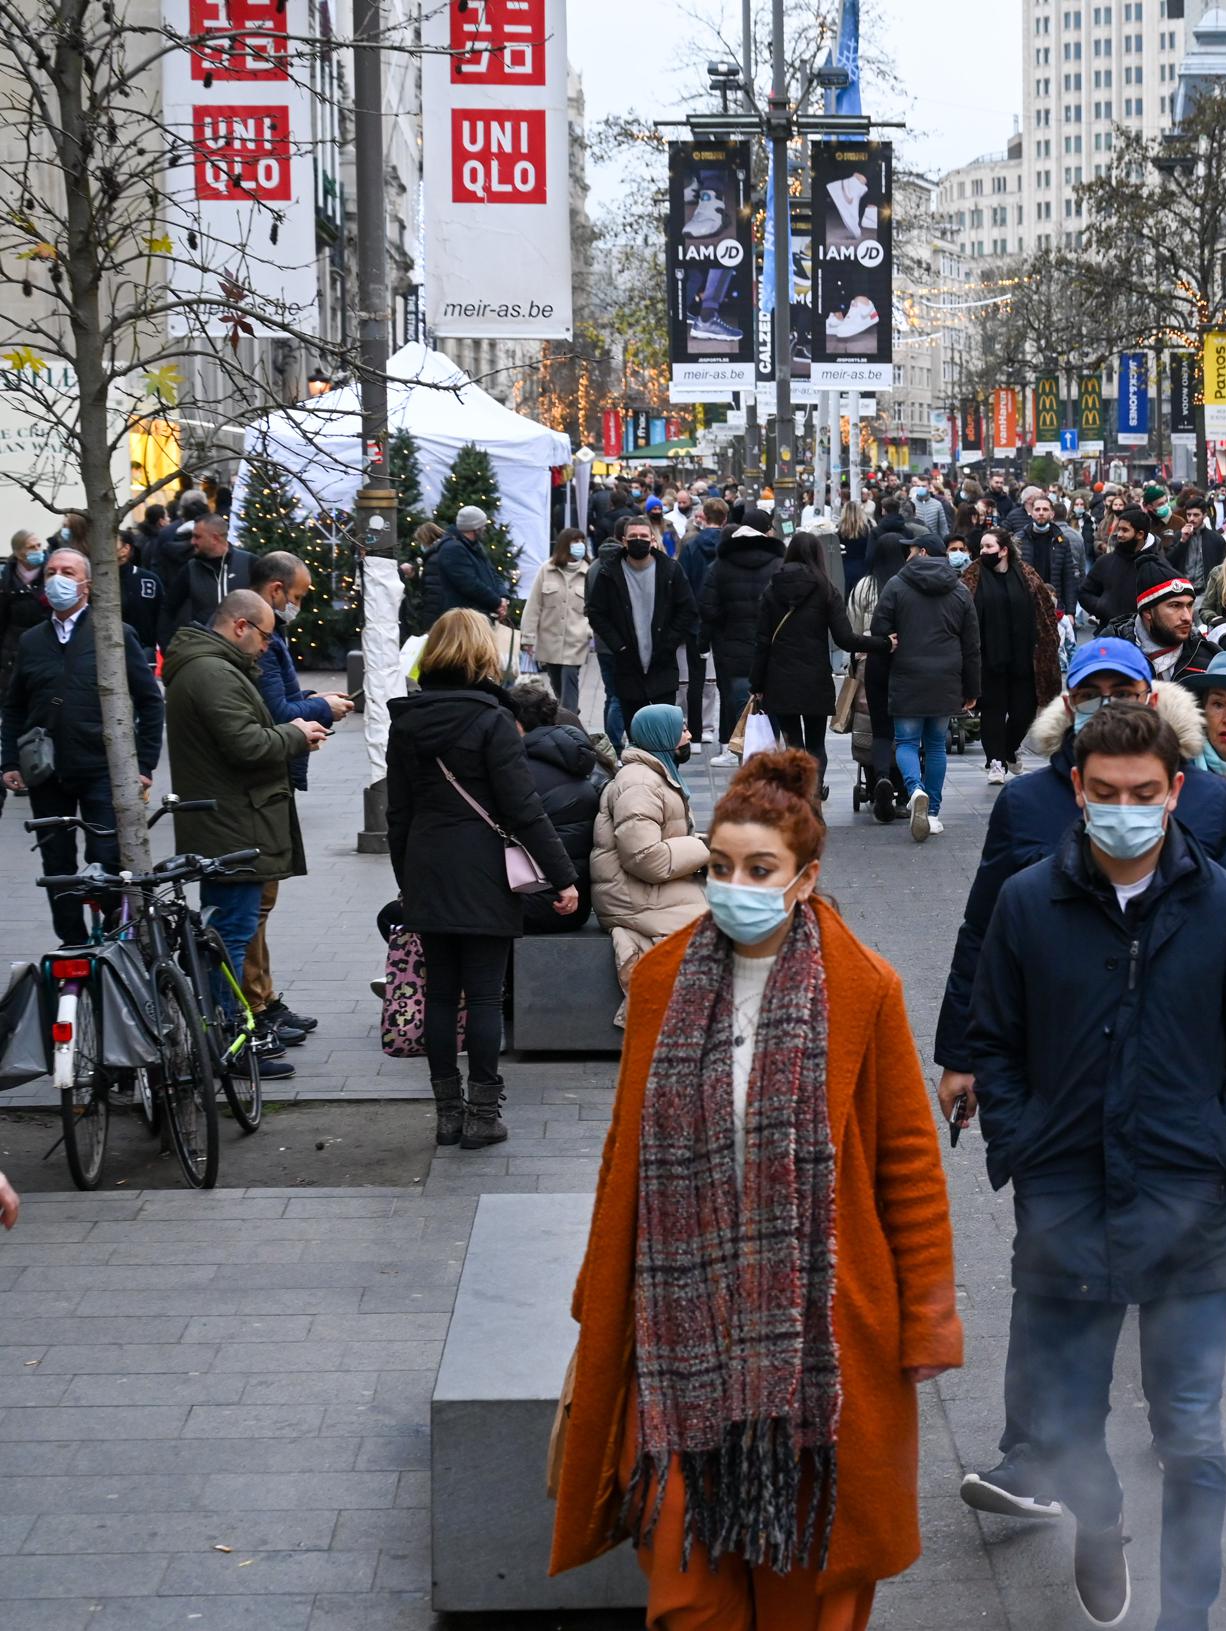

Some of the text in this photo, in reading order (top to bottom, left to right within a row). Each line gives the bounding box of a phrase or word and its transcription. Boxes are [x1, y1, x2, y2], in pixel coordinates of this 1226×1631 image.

[204, 117, 273, 150] UNI
[462, 121, 528, 153] UNI
[204, 156, 280, 195] QLO
[463, 160, 535, 197] QLO
[678, 245, 684, 260] I
[685, 245, 715, 260] AM
[819, 245, 824, 260] I
[826, 245, 855, 260] AM
[443, 300, 554, 318] meir-as.be
[683, 368, 745, 380] meir-as.be
[821, 368, 883, 380] meir-as.be
[1215, 346, 1226, 399] Panos
[141, 578, 157, 599] B
